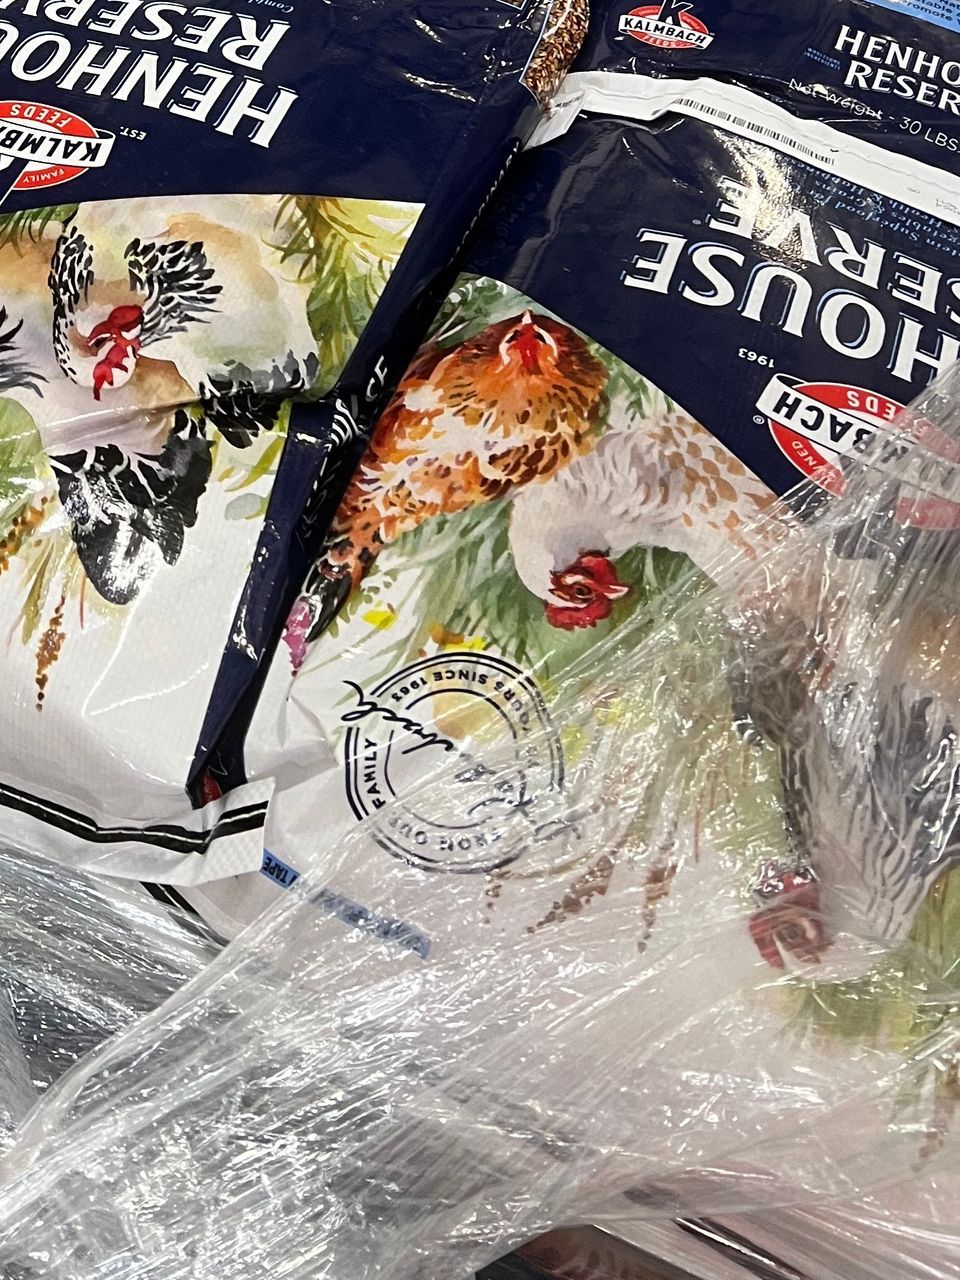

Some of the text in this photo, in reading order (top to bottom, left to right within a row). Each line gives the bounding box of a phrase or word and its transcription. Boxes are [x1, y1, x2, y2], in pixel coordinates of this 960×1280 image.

[623, 17, 711, 46] KALMBACH
[643, 35, 677, 48] FEEDS
[9, 103, 72, 127] FEEDS
[899, 116, 923, 135] 30
[119, 125, 148, 141] EST.
[21, 168, 66, 184] FAMILY
[814, 180, 868, 208] Grains
[834, 201, 920, 242] Superfood
[889, 199, 943, 228] Health
[737, 346, 777, 368] 1963
[391, 669, 488, 704] SINCE 1963
[362, 736, 388, 810] FAMILY
[263, 857, 290, 881] TAPE
